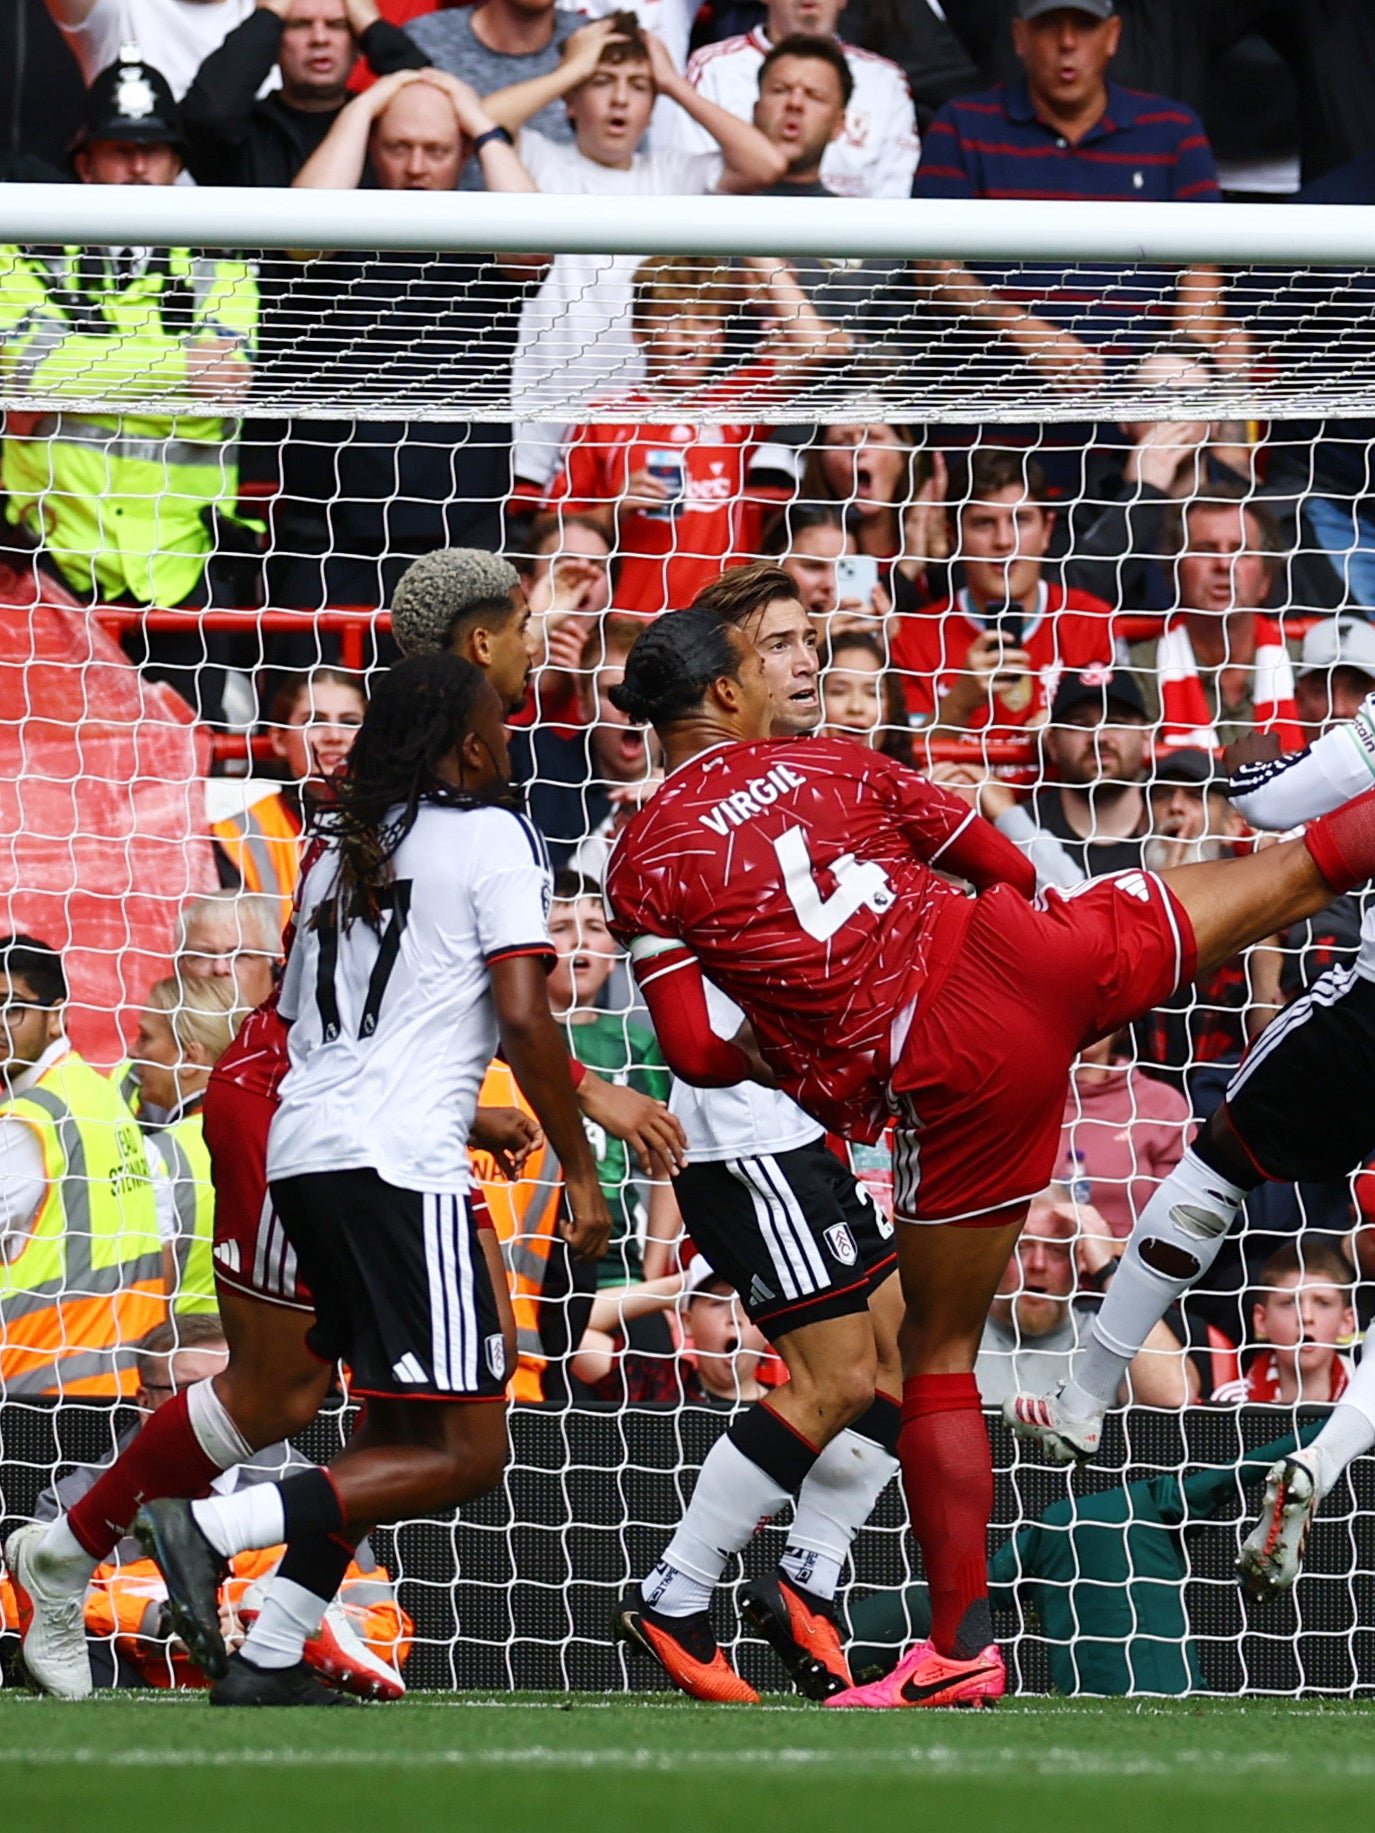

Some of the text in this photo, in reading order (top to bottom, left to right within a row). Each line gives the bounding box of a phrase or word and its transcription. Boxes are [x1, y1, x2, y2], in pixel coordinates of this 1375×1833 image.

[698, 763, 807, 837] VIRGIL
[773, 824, 897, 943] 4
[314, 878, 414, 1045] 17
